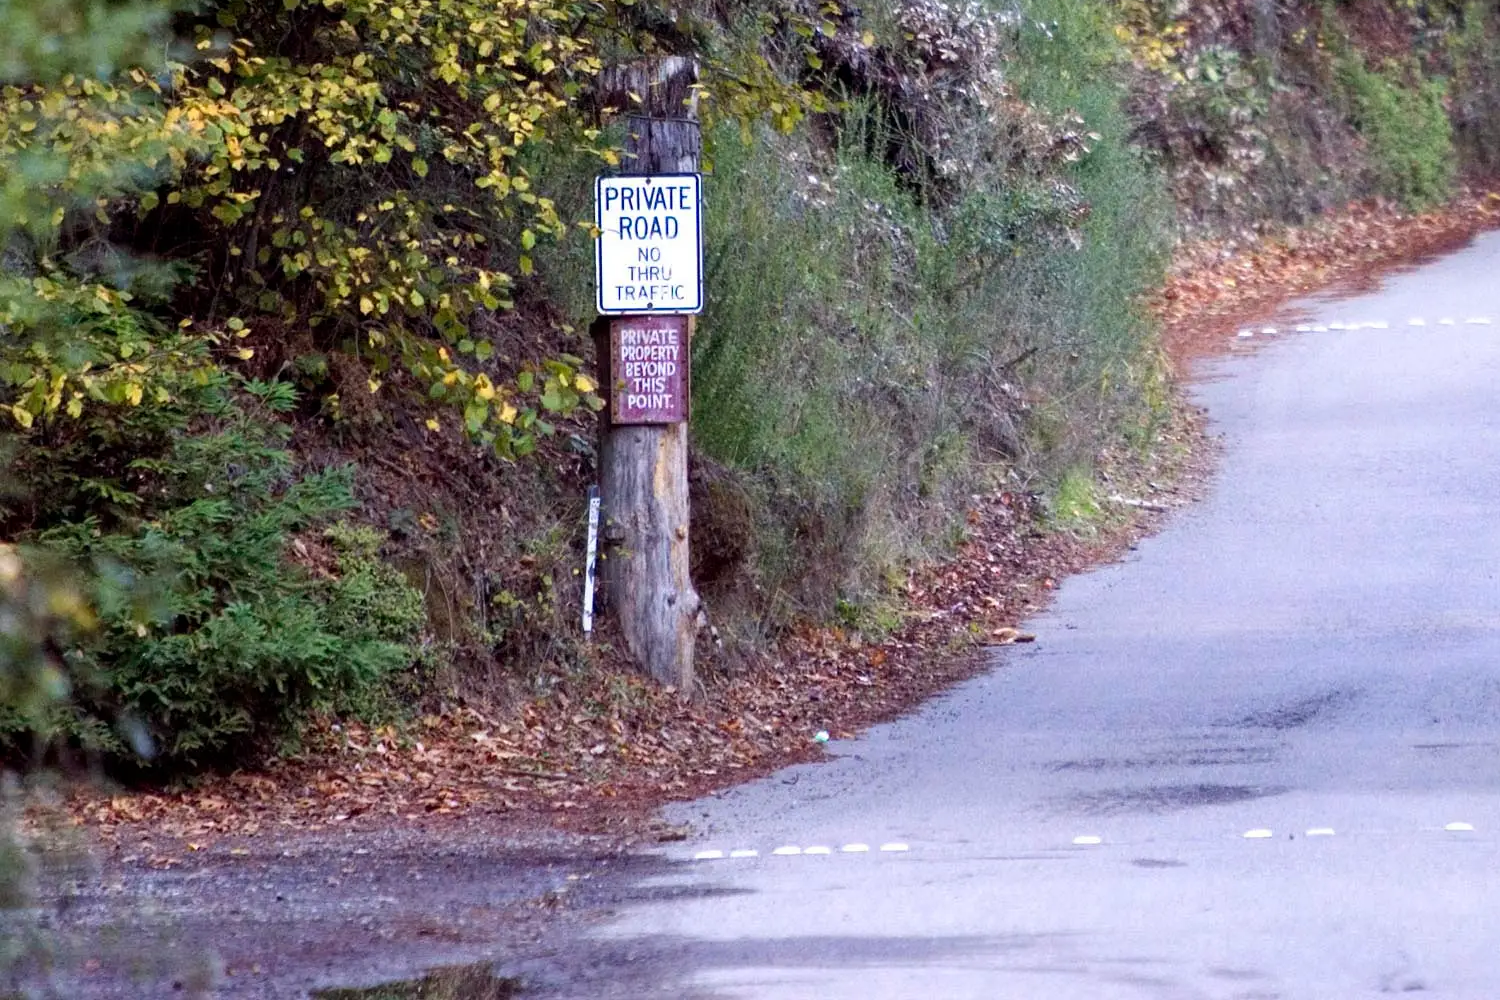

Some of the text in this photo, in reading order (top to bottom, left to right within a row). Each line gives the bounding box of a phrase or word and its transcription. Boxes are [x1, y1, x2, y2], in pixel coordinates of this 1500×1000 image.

[605, 186, 691, 211] PRIVATE
[619, 215, 678, 240] ROAD
[638, 246, 661, 262] NO
[628, 266, 672, 281] THRU
[615, 285, 685, 301] TRAFFIC
[621, 329, 678, 345] PRIVATE
[621, 345, 679, 361] PROPERTY
[625, 361, 676, 377] BEYOND
[633, 377, 666, 393] THIS
[628, 394, 675, 409] POINT.
